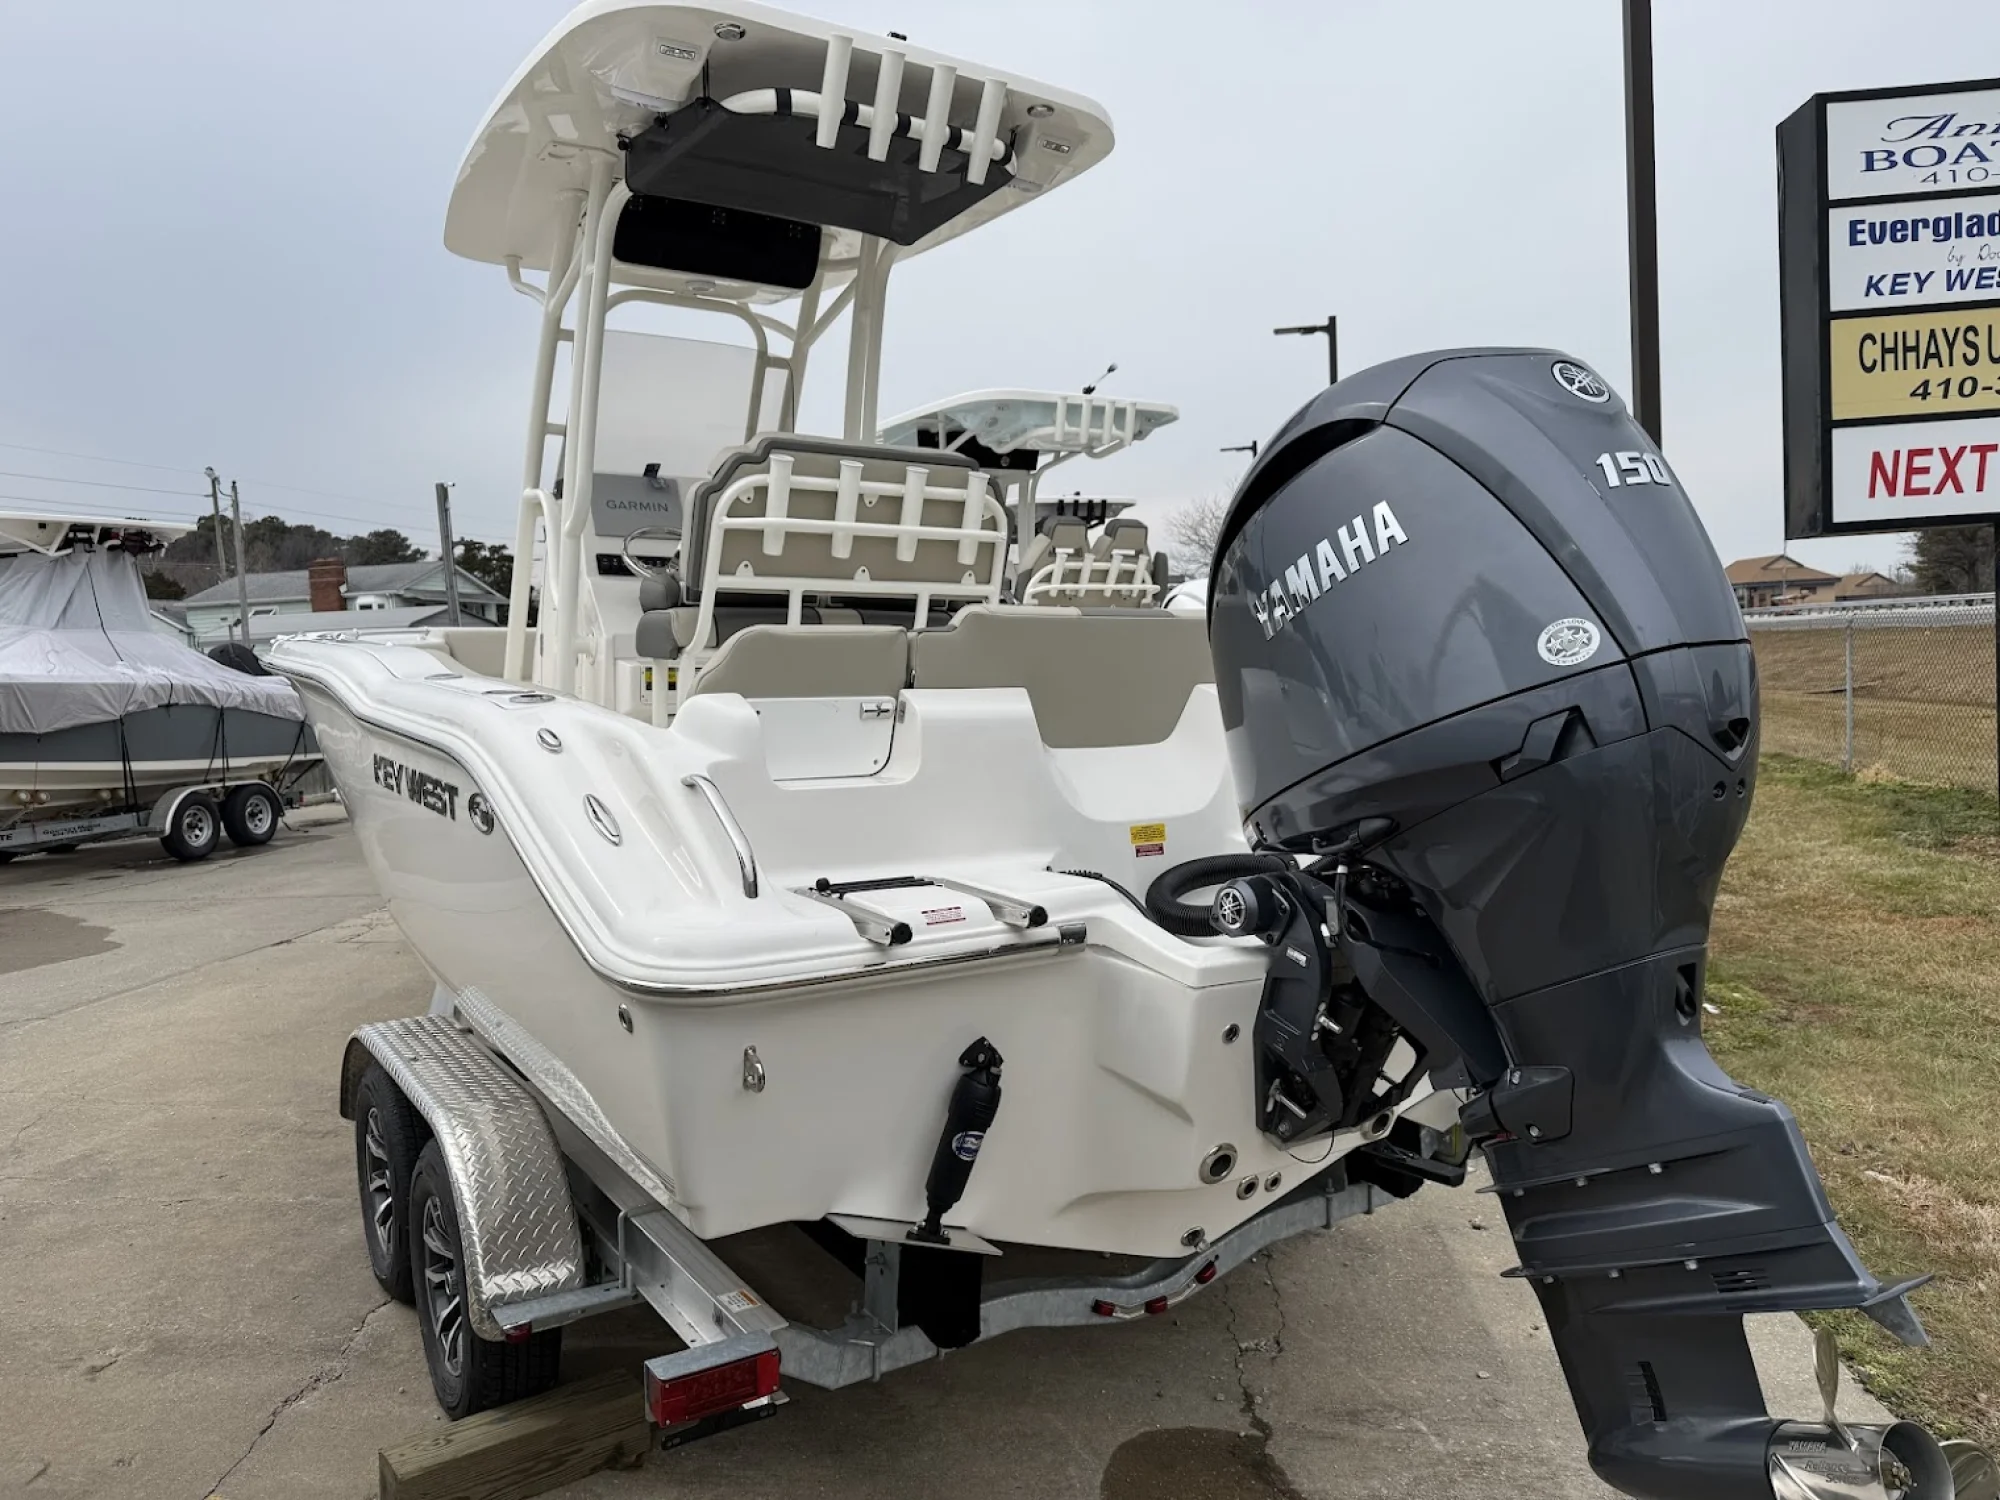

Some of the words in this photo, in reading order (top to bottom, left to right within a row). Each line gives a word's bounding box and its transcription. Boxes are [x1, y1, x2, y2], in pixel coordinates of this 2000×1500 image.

[1947, 245, 1965, 267] by
[1864, 270, 1936, 297] KEY
[1945, 266, 2000, 292] WE
[1859, 325, 1980, 374] CHHAYS
[1596, 452, 1672, 489] 150
[1868, 443, 1999, 498] NEXT
[606, 500, 669, 512] GARMIN
[1253, 500, 1409, 641] YAMAHA
[374, 753, 404, 795] KEY
[405, 766, 458, 821] WEST
[1788, 1441, 1827, 1454] YAMAHA
